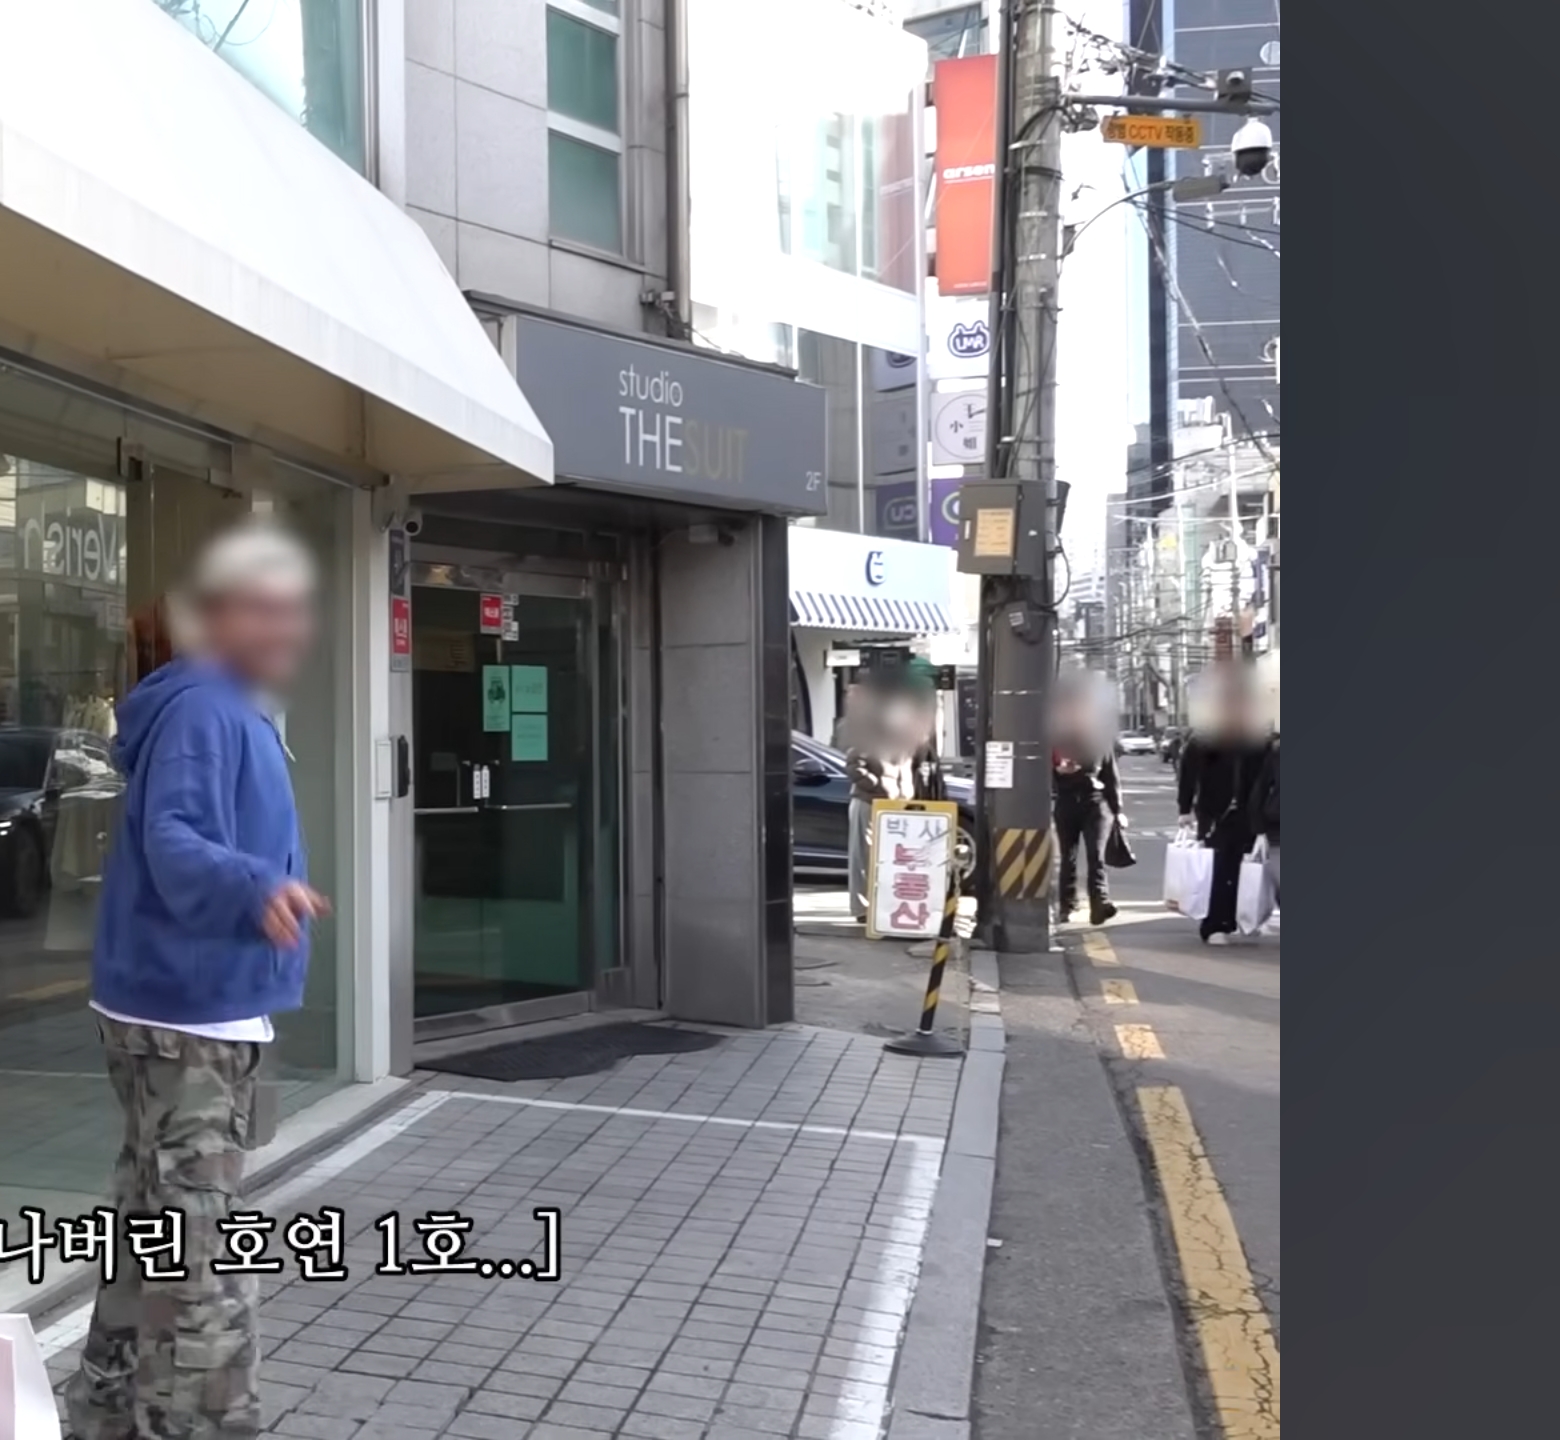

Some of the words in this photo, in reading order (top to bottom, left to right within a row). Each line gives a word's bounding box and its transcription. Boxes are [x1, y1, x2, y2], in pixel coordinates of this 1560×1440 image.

[1128, 123, 1163, 141] CCTV
[618, 363, 684, 408] studio
[805, 471, 822, 492] 2F
